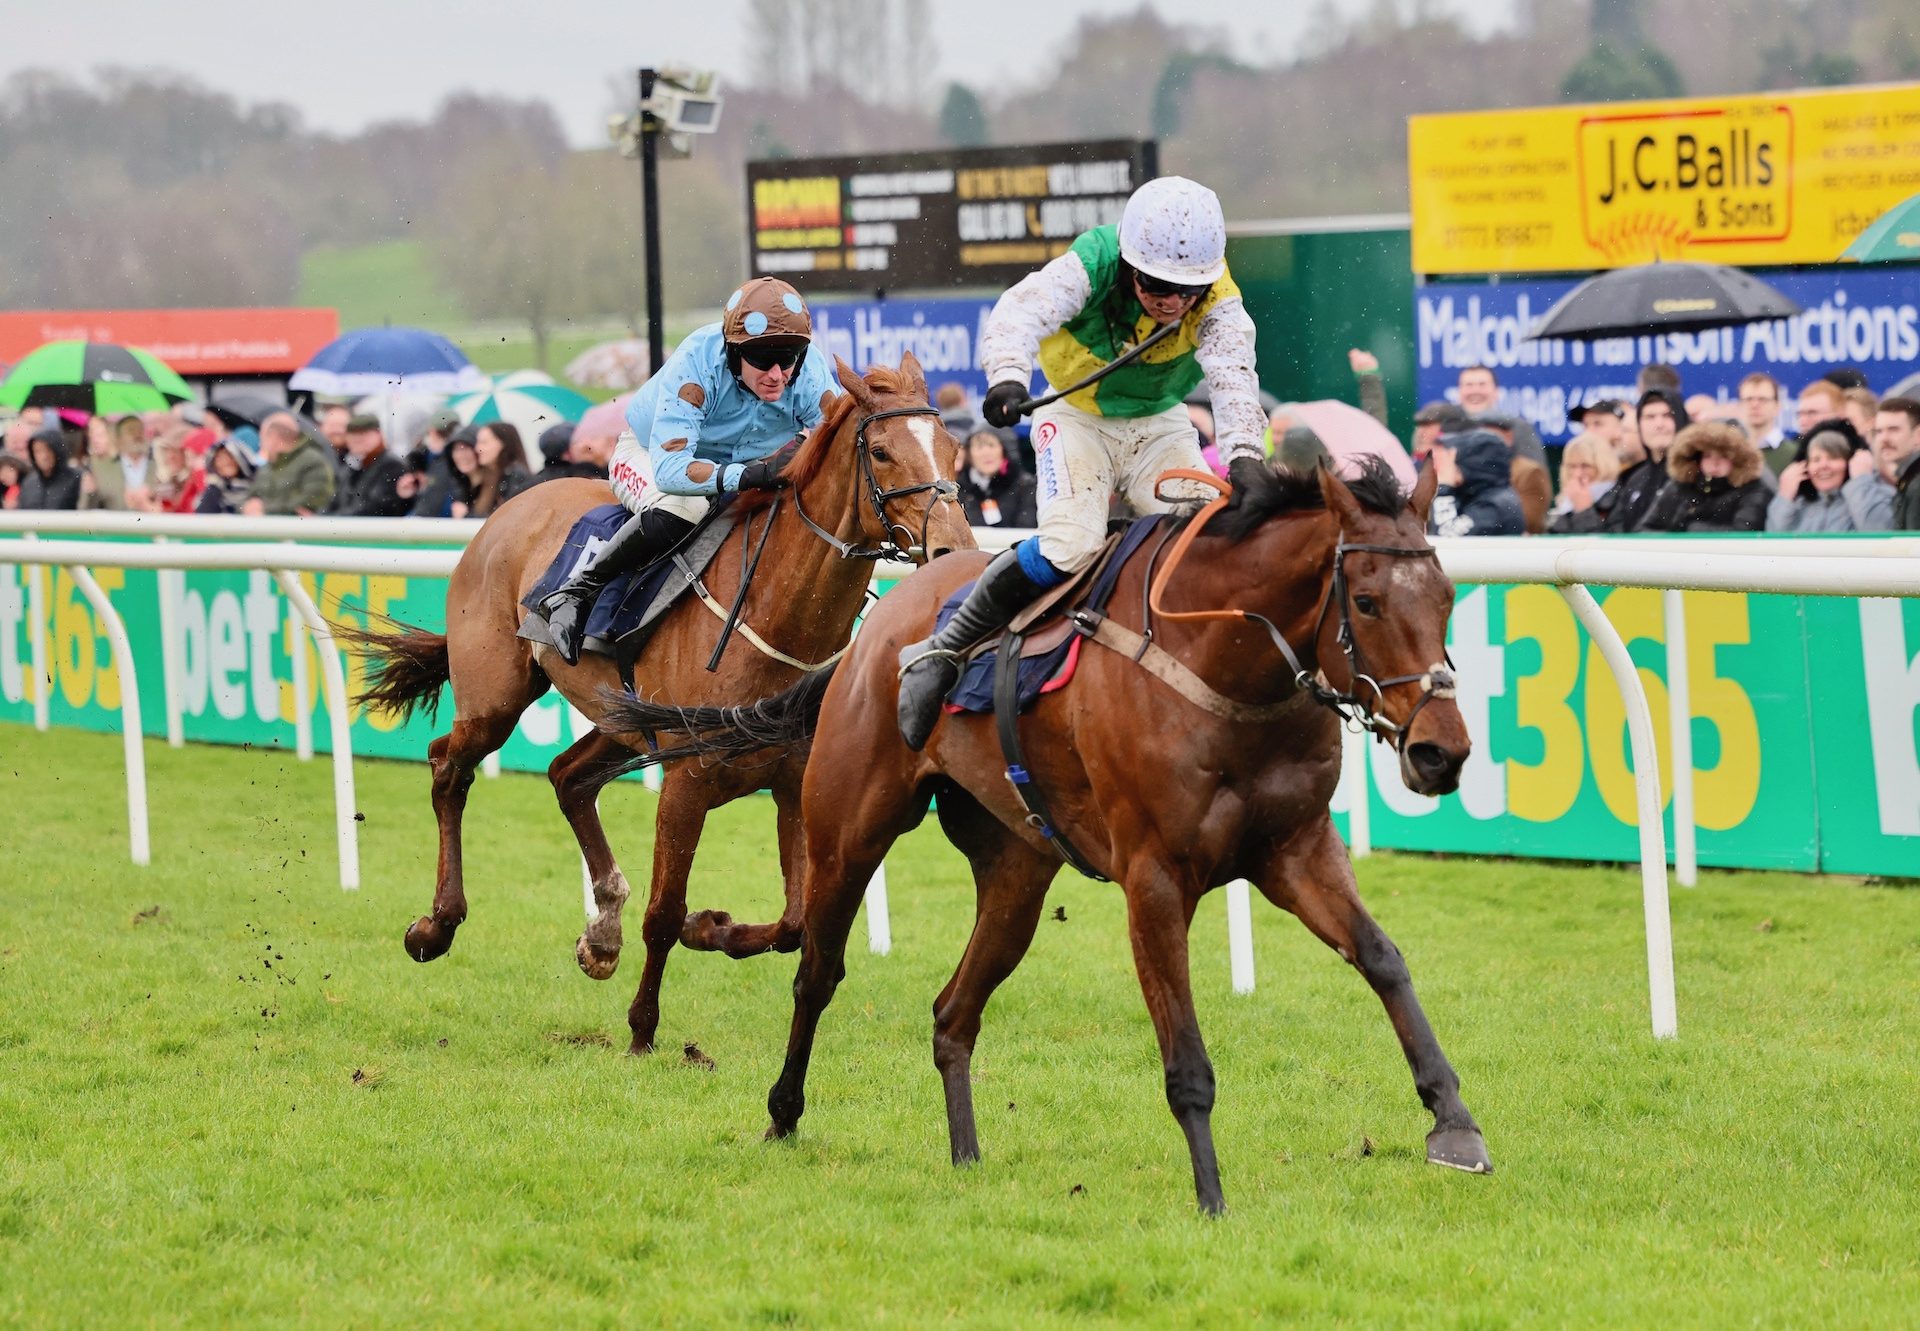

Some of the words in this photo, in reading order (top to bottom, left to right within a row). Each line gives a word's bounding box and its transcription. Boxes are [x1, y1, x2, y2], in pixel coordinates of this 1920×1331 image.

[1600, 129, 1774, 203] J.C.Balls
[1695, 199, 1707, 228] &
[1719, 197, 1774, 228] Sons
[854, 307, 970, 372] Harrison
